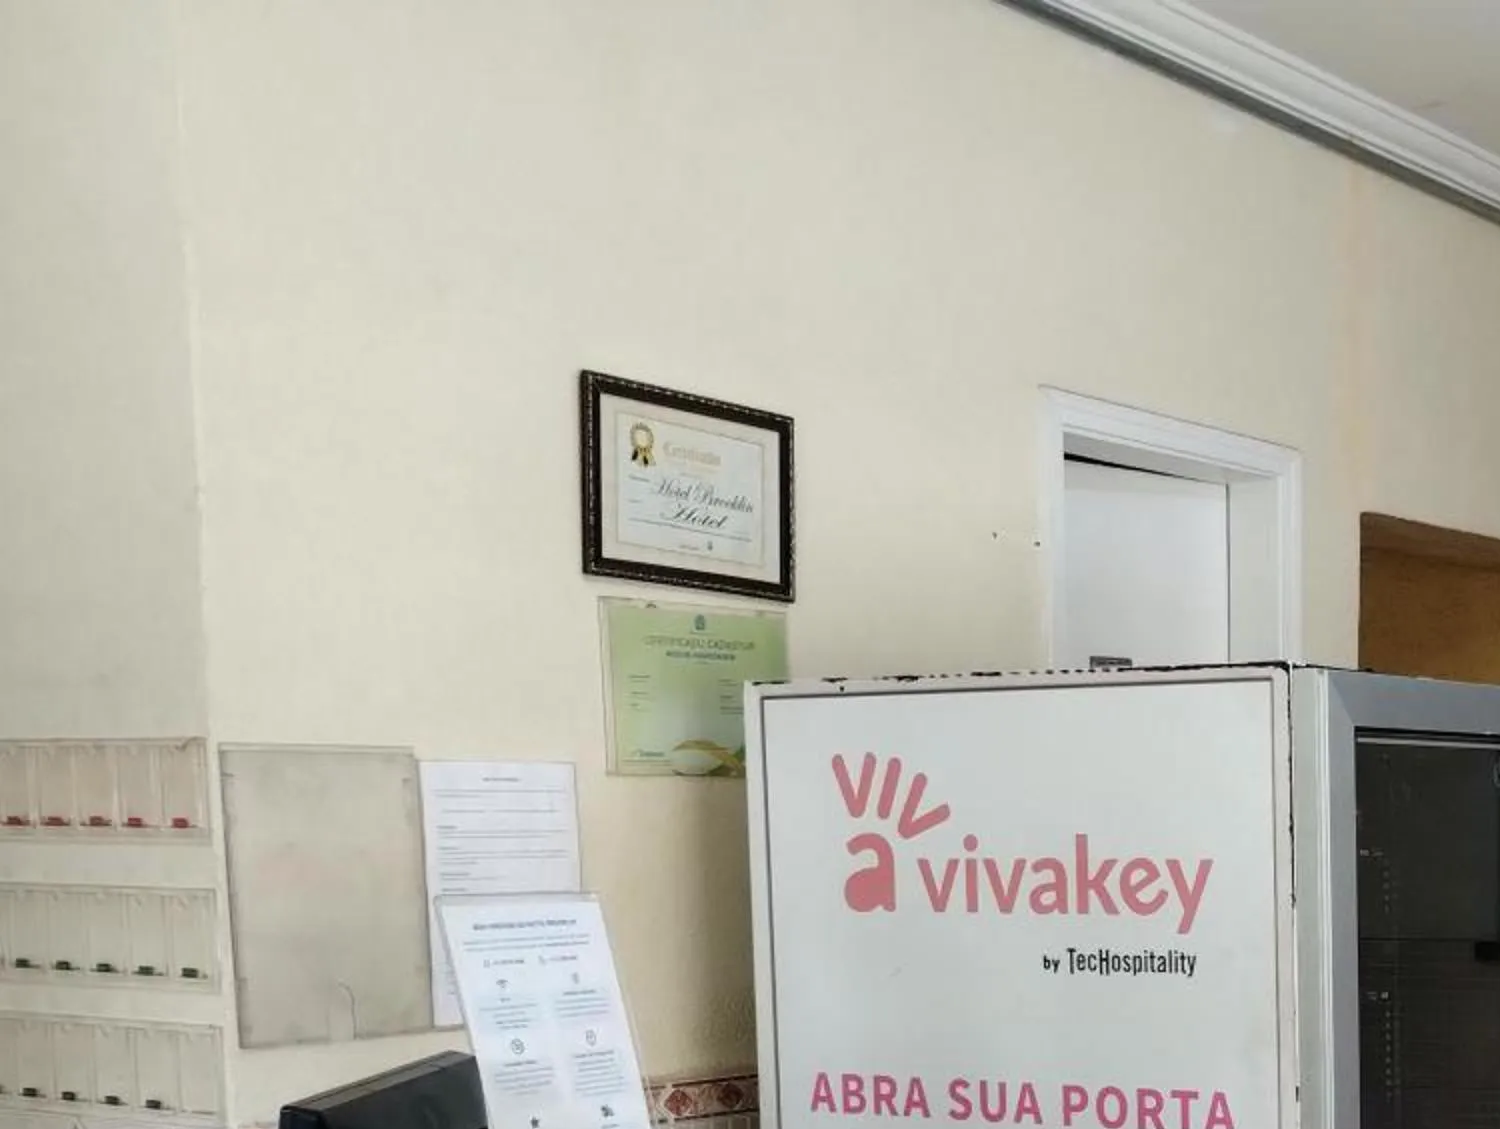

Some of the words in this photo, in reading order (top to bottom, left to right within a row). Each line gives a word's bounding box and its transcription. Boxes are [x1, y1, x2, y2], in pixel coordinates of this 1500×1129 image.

[916, 833, 1213, 935] vivakey
[1042, 954, 1061, 975] by
[1067, 947, 1197, 977] TecHospitality
[810, 1072, 931, 1119] ABRA
[948, 1078, 1043, 1124] SUA
